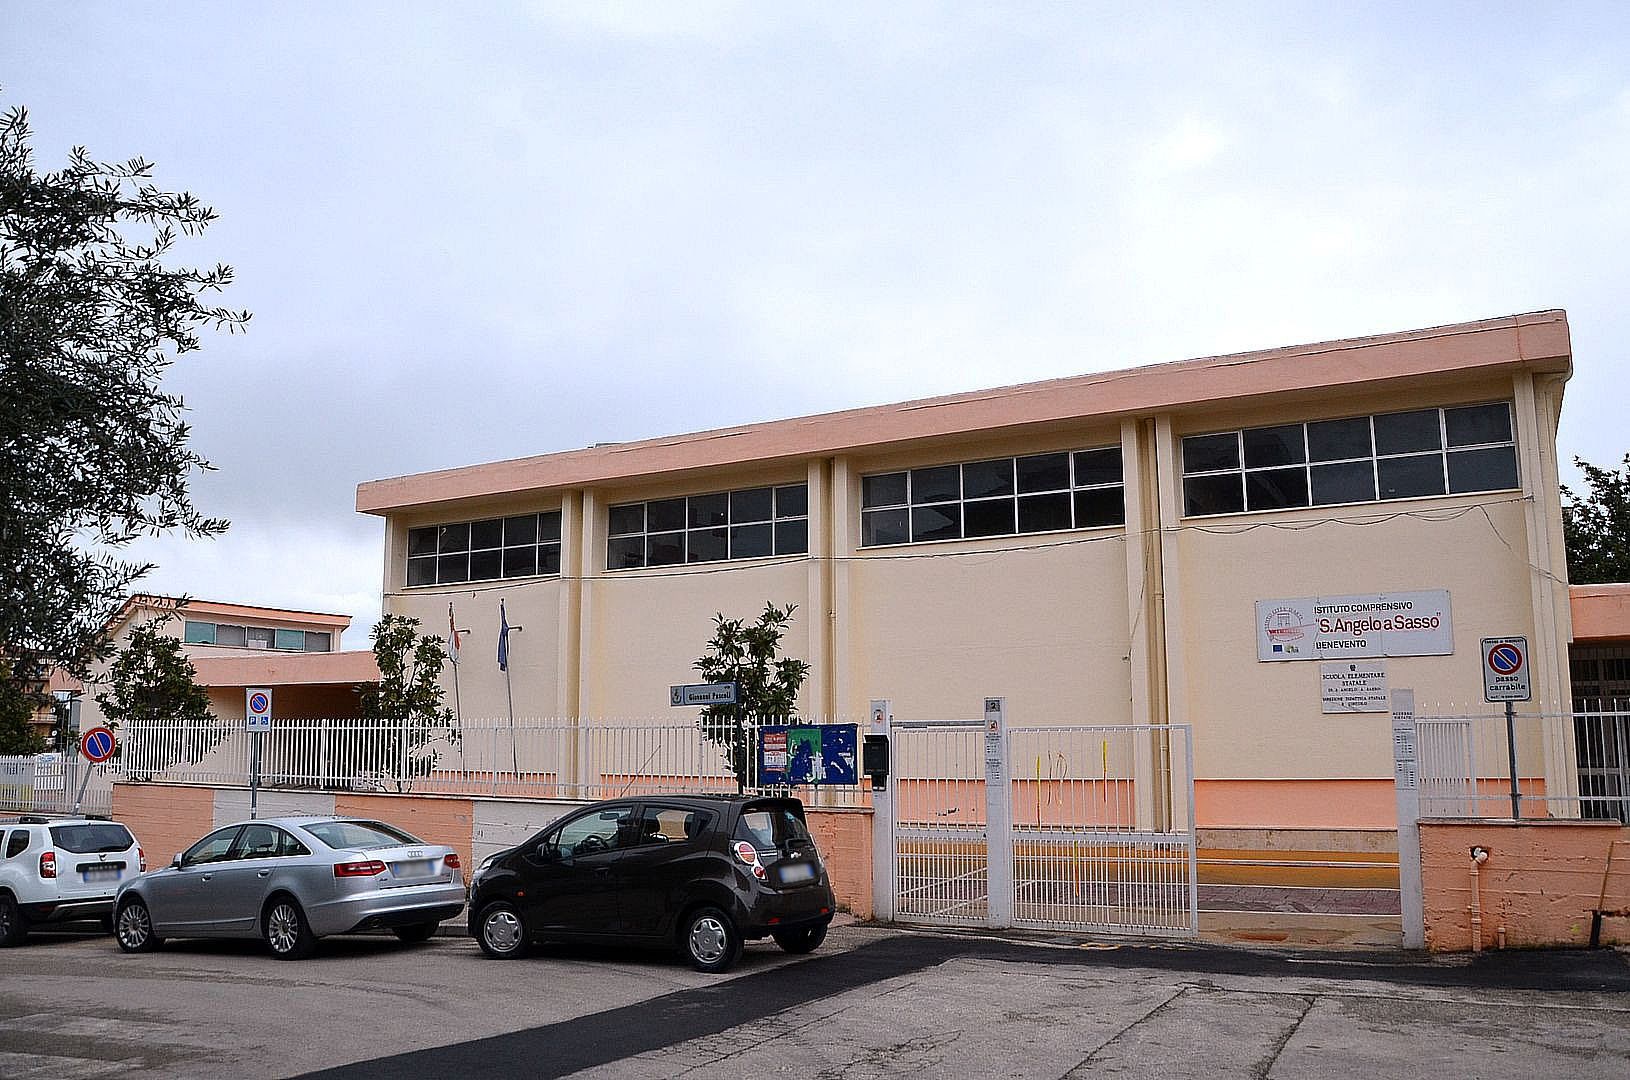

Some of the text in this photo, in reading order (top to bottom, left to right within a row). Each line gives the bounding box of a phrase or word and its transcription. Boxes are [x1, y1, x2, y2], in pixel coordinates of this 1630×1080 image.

[1314, 601, 1413, 614] ISTITUTO COMPRENSIVO
[1315, 616, 1382, 636] "S.Angelo
[1384, 618, 1393, 631] a
[1394, 611, 1441, 630] Sasso"
[1315, 639, 1367, 650] BENEVENTO
[1489, 683, 1526, 691] carrabile
